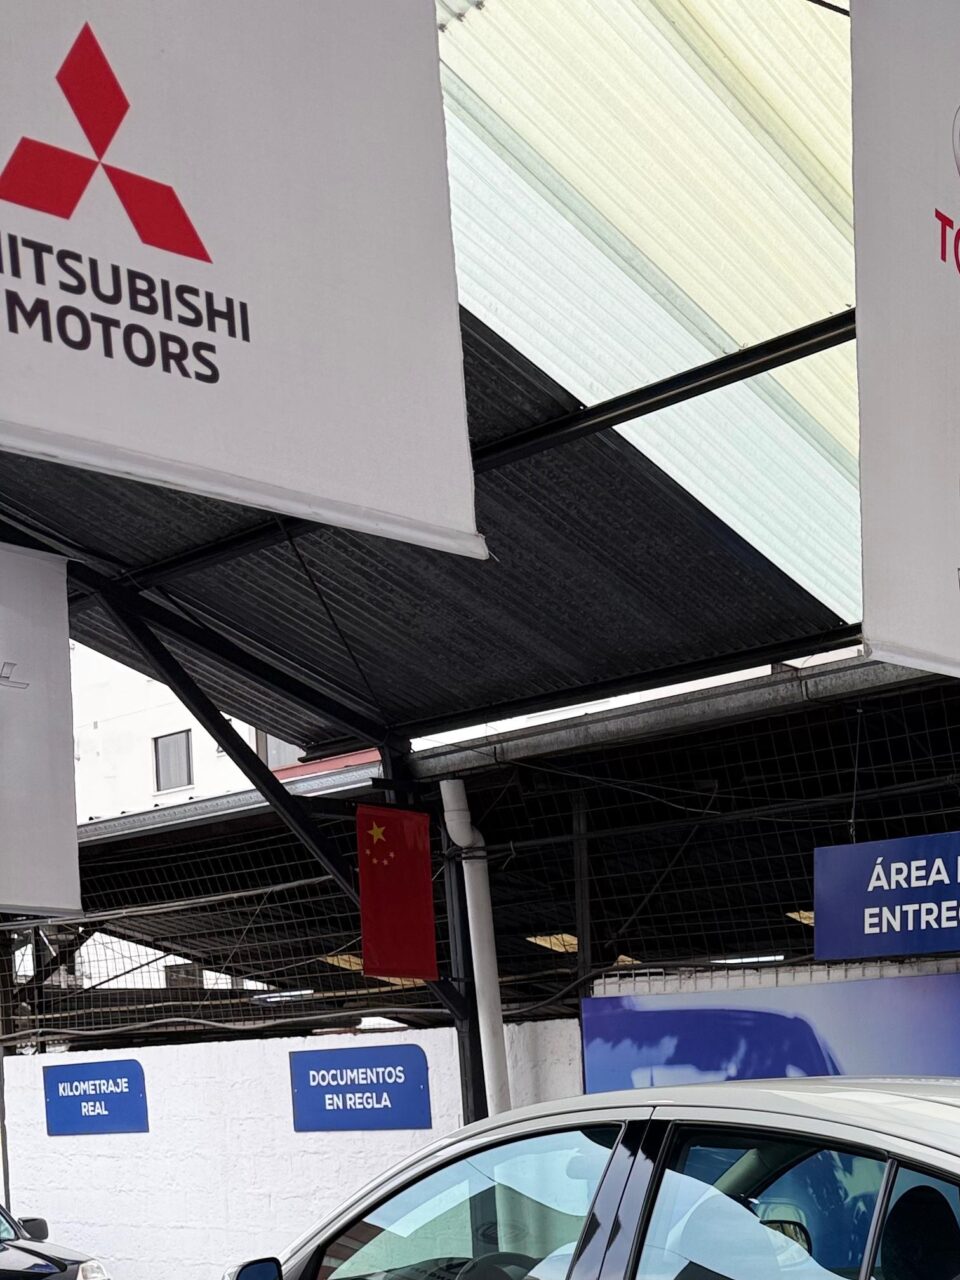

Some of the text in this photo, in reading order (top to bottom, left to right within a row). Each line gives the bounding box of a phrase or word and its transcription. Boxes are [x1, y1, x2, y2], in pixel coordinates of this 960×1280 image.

[0, 229, 251, 343] ITSUBISHI
[5, 289, 220, 385] MOTORS
[866, 856, 951, 892] ÁREA
[58, 1077, 130, 1097] KILOMETRAJE
[308, 1065, 406, 1087] DOCUMENTOS
[81, 1101, 109, 1117] REAL
[324, 1091, 392, 1111] EN REGLA
